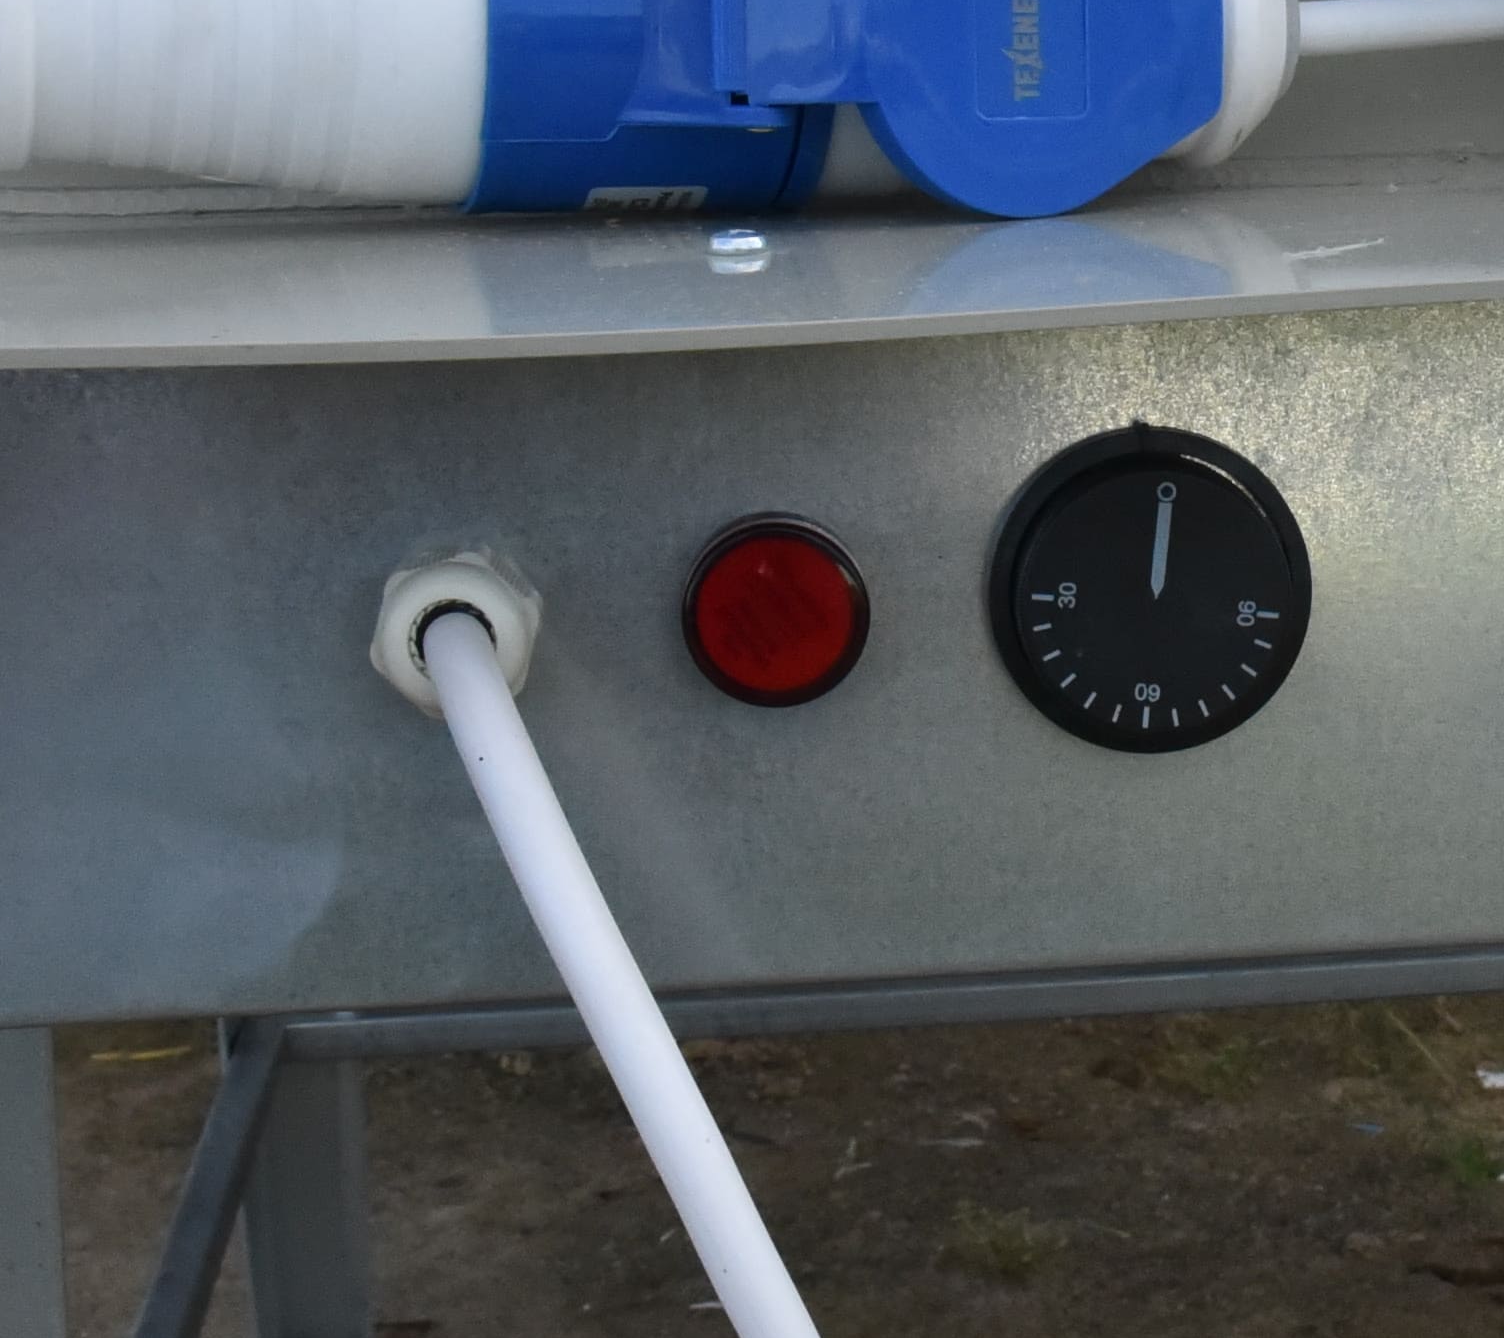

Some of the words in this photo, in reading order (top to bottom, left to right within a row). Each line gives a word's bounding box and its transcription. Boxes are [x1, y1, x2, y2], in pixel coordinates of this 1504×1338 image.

[1058, 582, 1077, 609] 30
[1236, 600, 1257, 627] 90
[1134, 682, 1161, 702] 60
